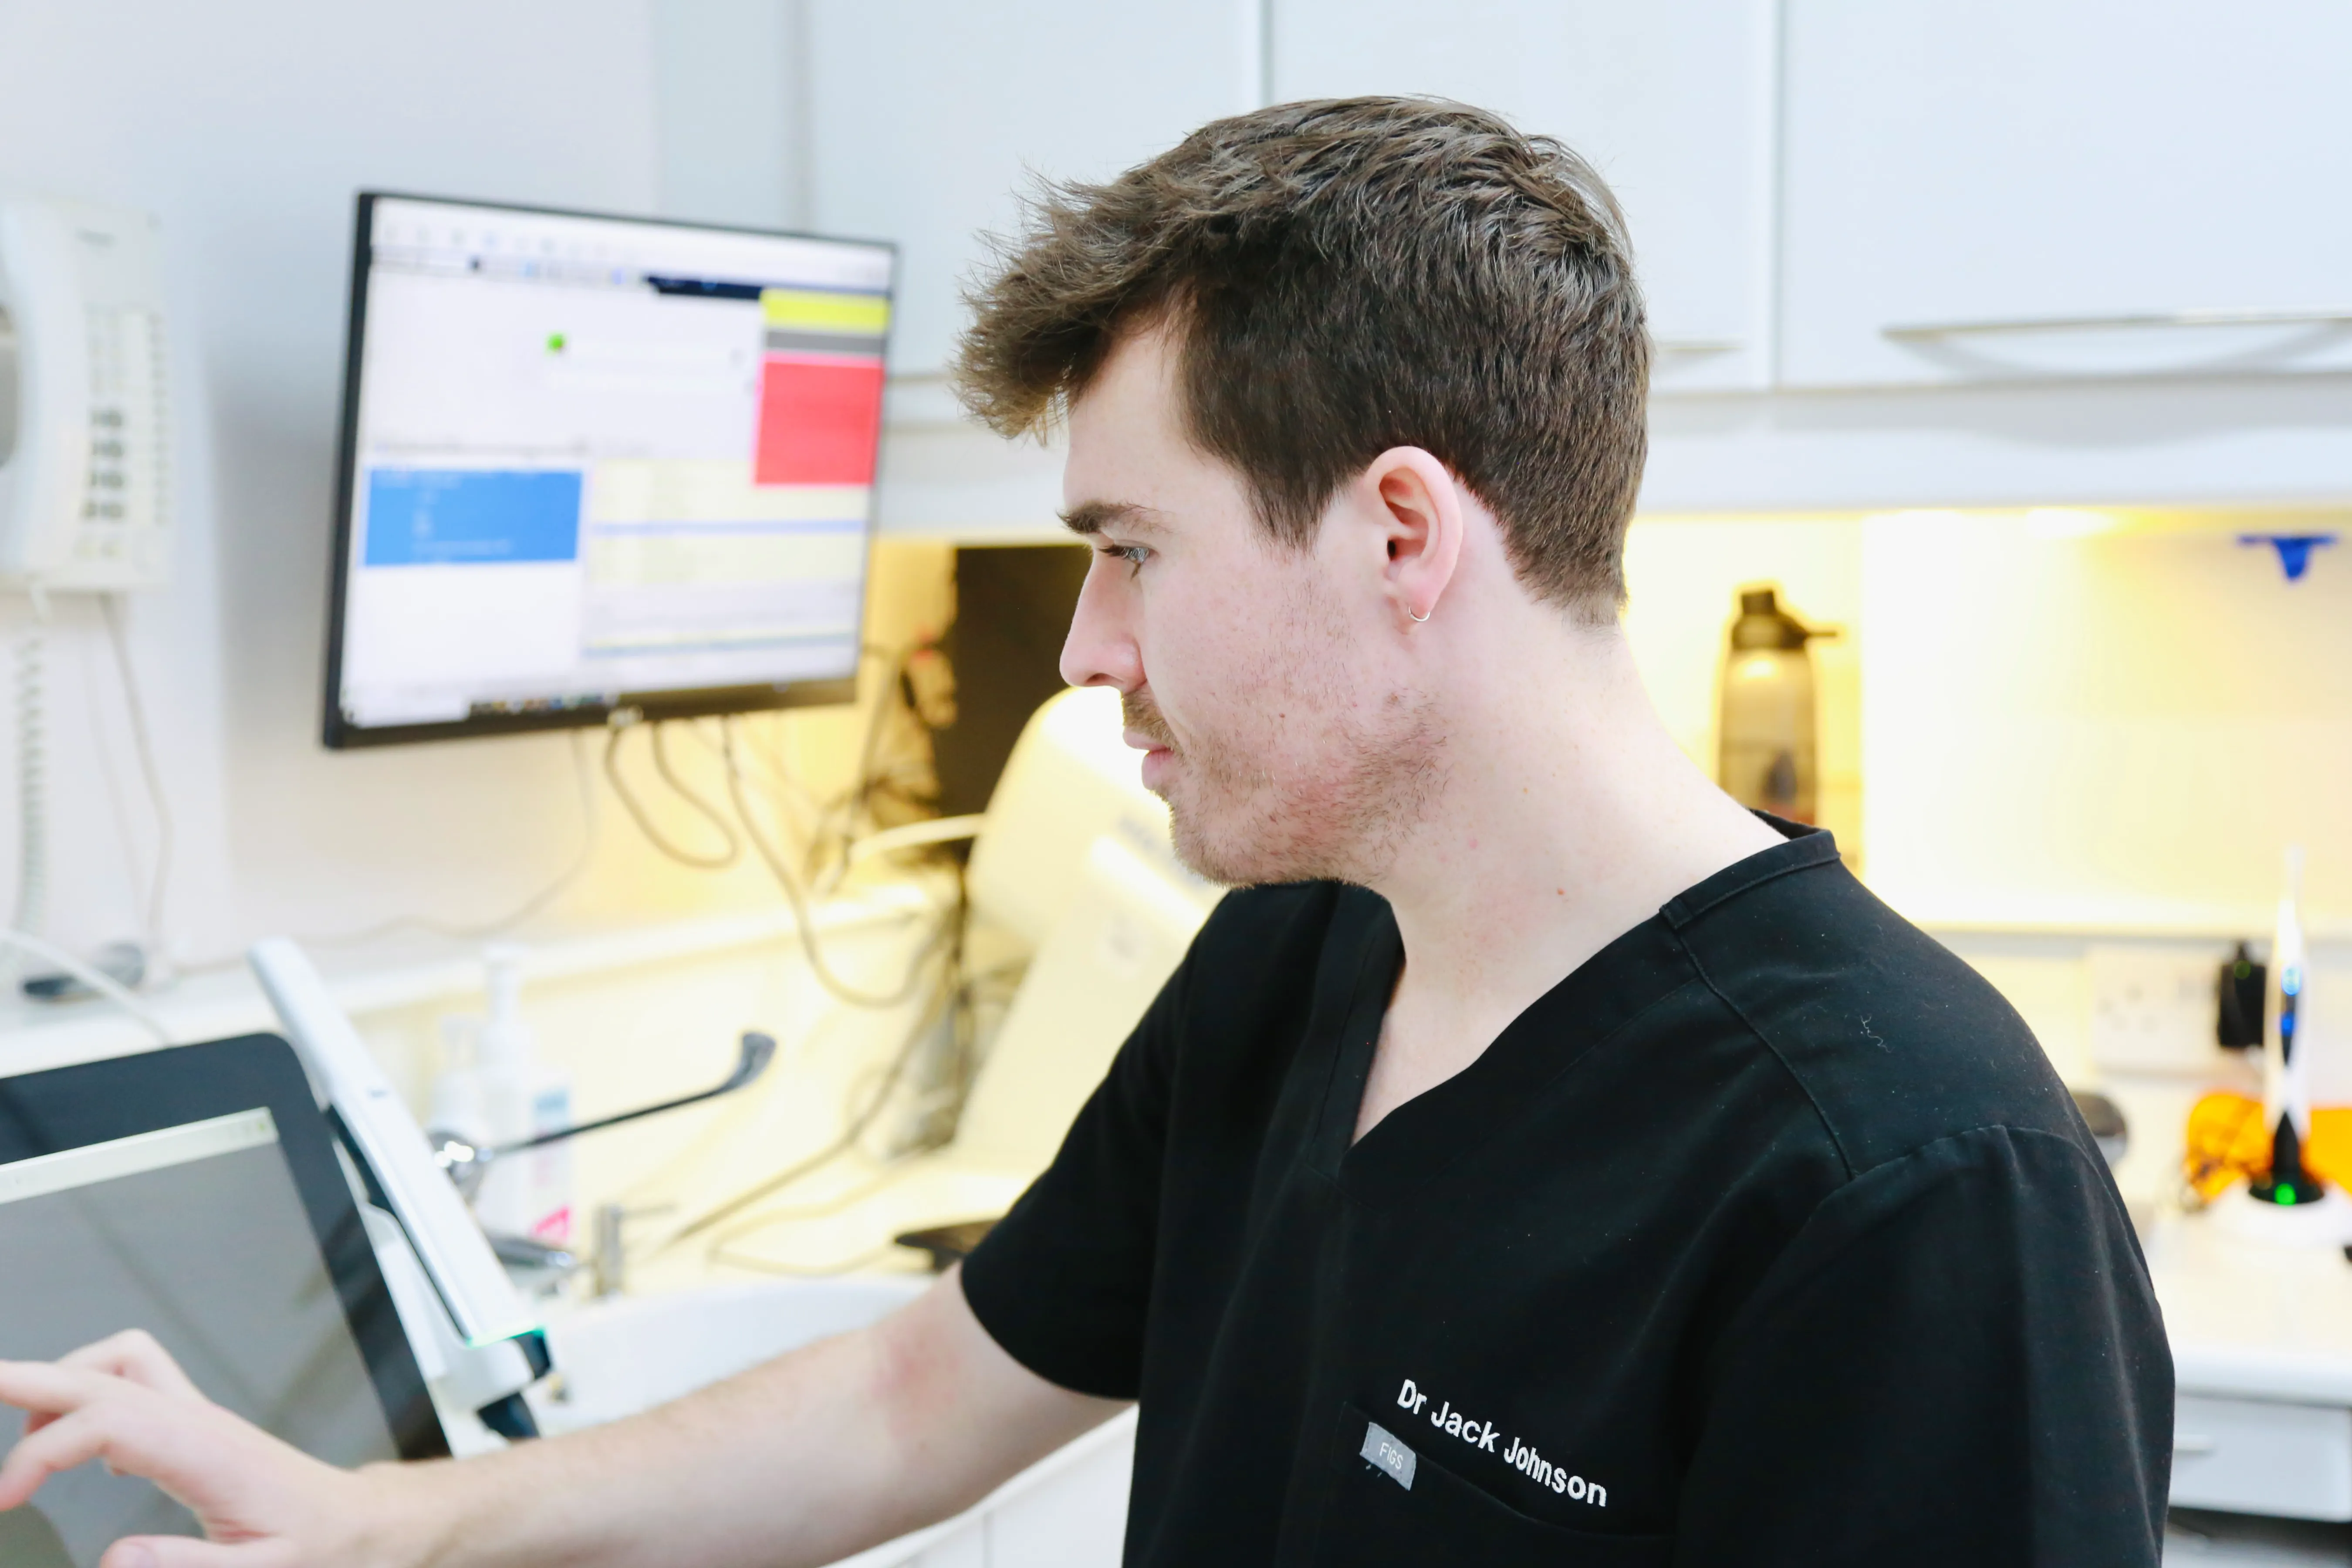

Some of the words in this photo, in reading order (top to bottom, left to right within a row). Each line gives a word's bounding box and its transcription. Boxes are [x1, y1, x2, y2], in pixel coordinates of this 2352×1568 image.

[1379, 1442, 1403, 1470] FIGS
[1397, 1379, 1427, 1415] Dr
[1431, 1401, 1500, 1453] Jack
[1504, 1436, 1607, 1507] Johnson
